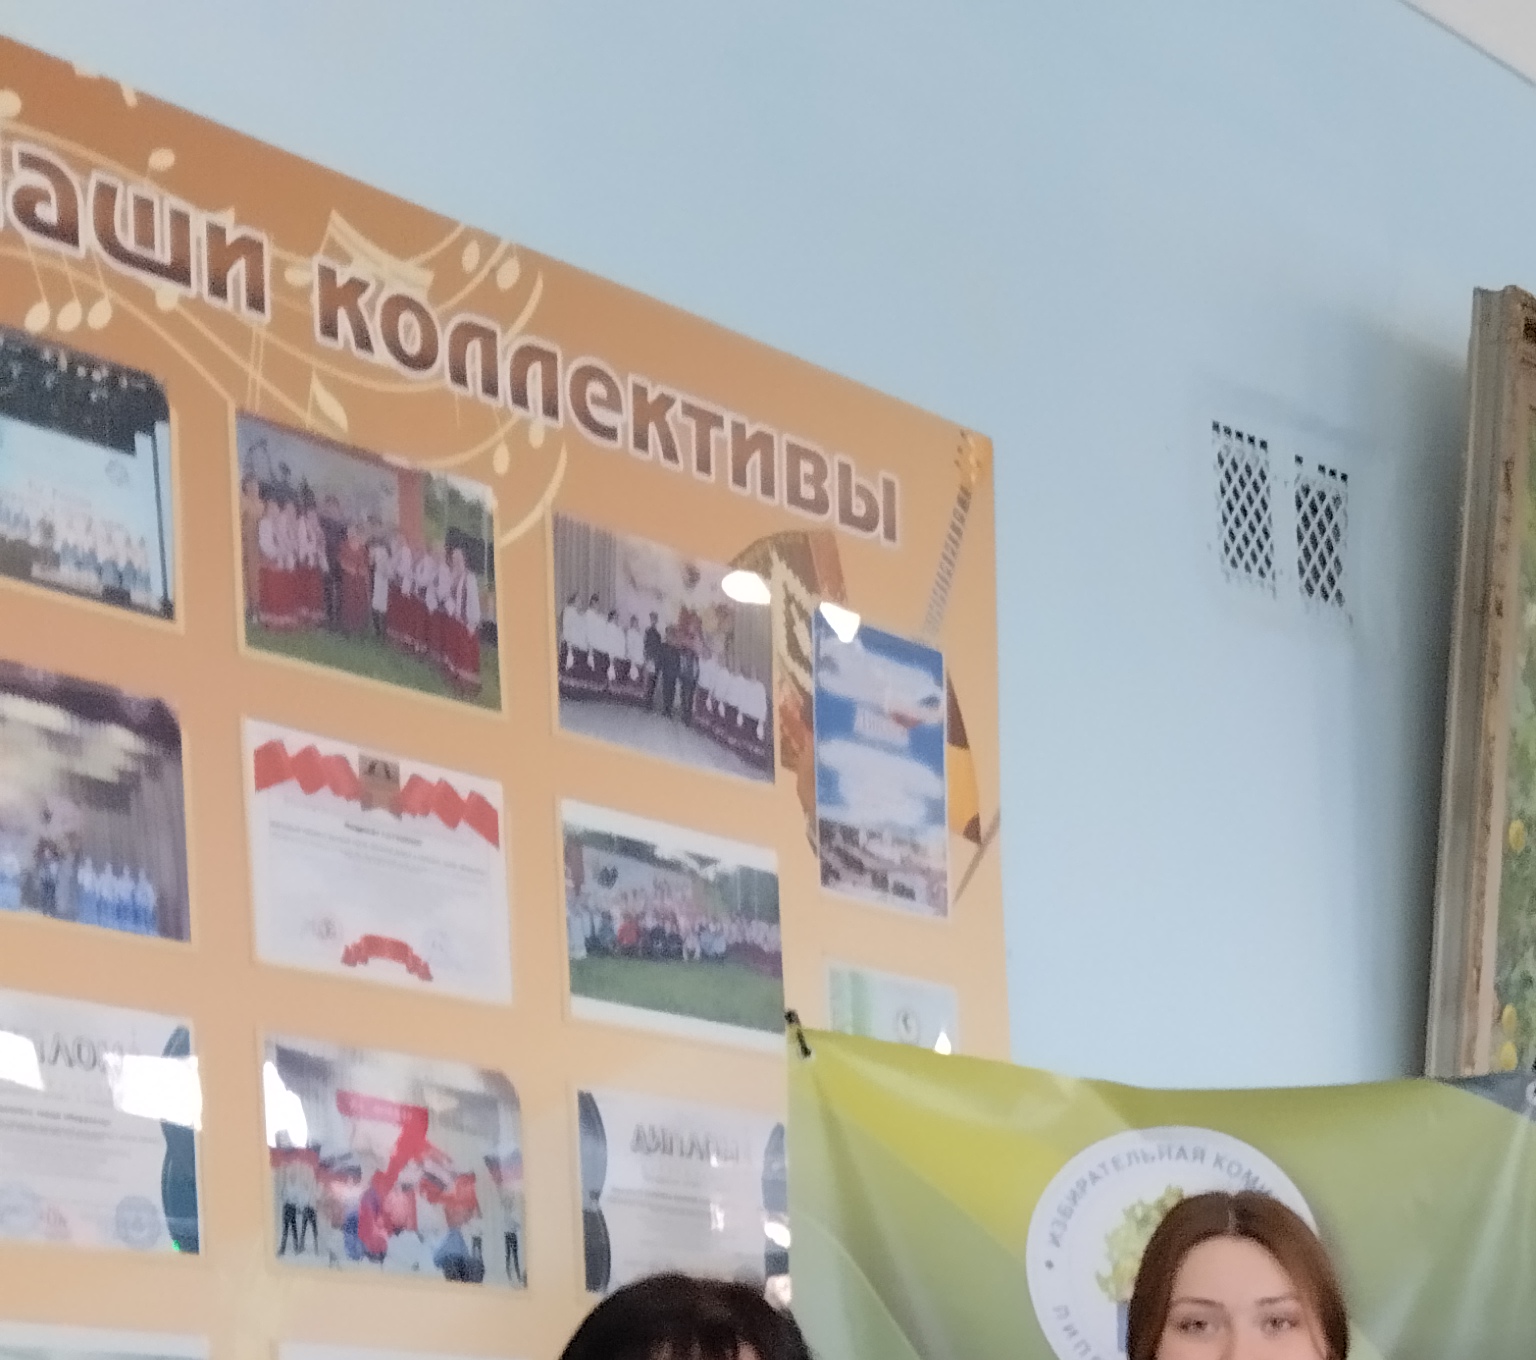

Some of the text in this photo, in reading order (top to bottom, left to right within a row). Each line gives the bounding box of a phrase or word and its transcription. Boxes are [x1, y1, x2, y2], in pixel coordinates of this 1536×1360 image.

[0, 140, 898, 545] аши коллективы
[1049, 1144, 1206, 1247] ИЗБИРАТЕЛЬНАЯ
